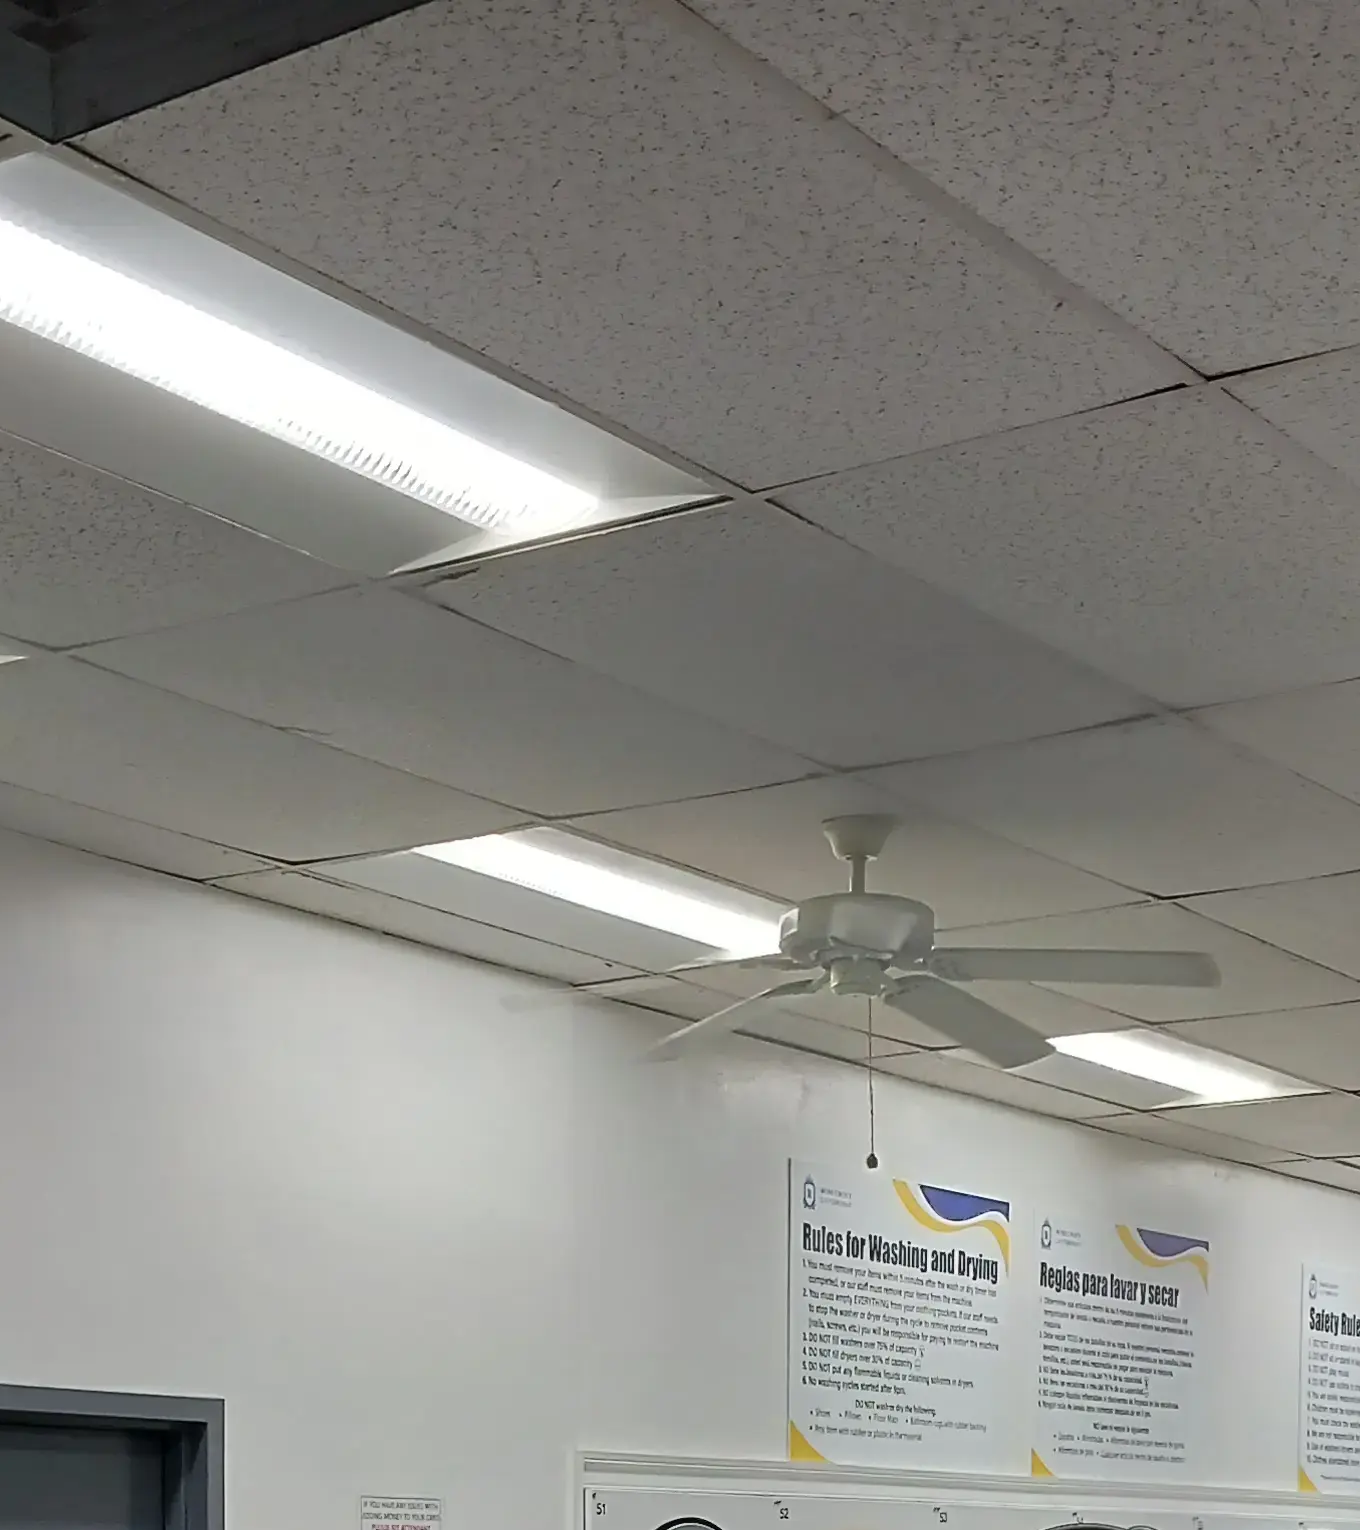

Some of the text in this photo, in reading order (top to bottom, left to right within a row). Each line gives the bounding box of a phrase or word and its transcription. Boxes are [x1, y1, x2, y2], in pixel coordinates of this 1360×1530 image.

[803, 1222, 999, 1285] Rules for Washing and Drying
[1040, 1261, 1180, 1308] Reglas para lavar y secar
[1309, 1306, 1339, 1337] Safety
